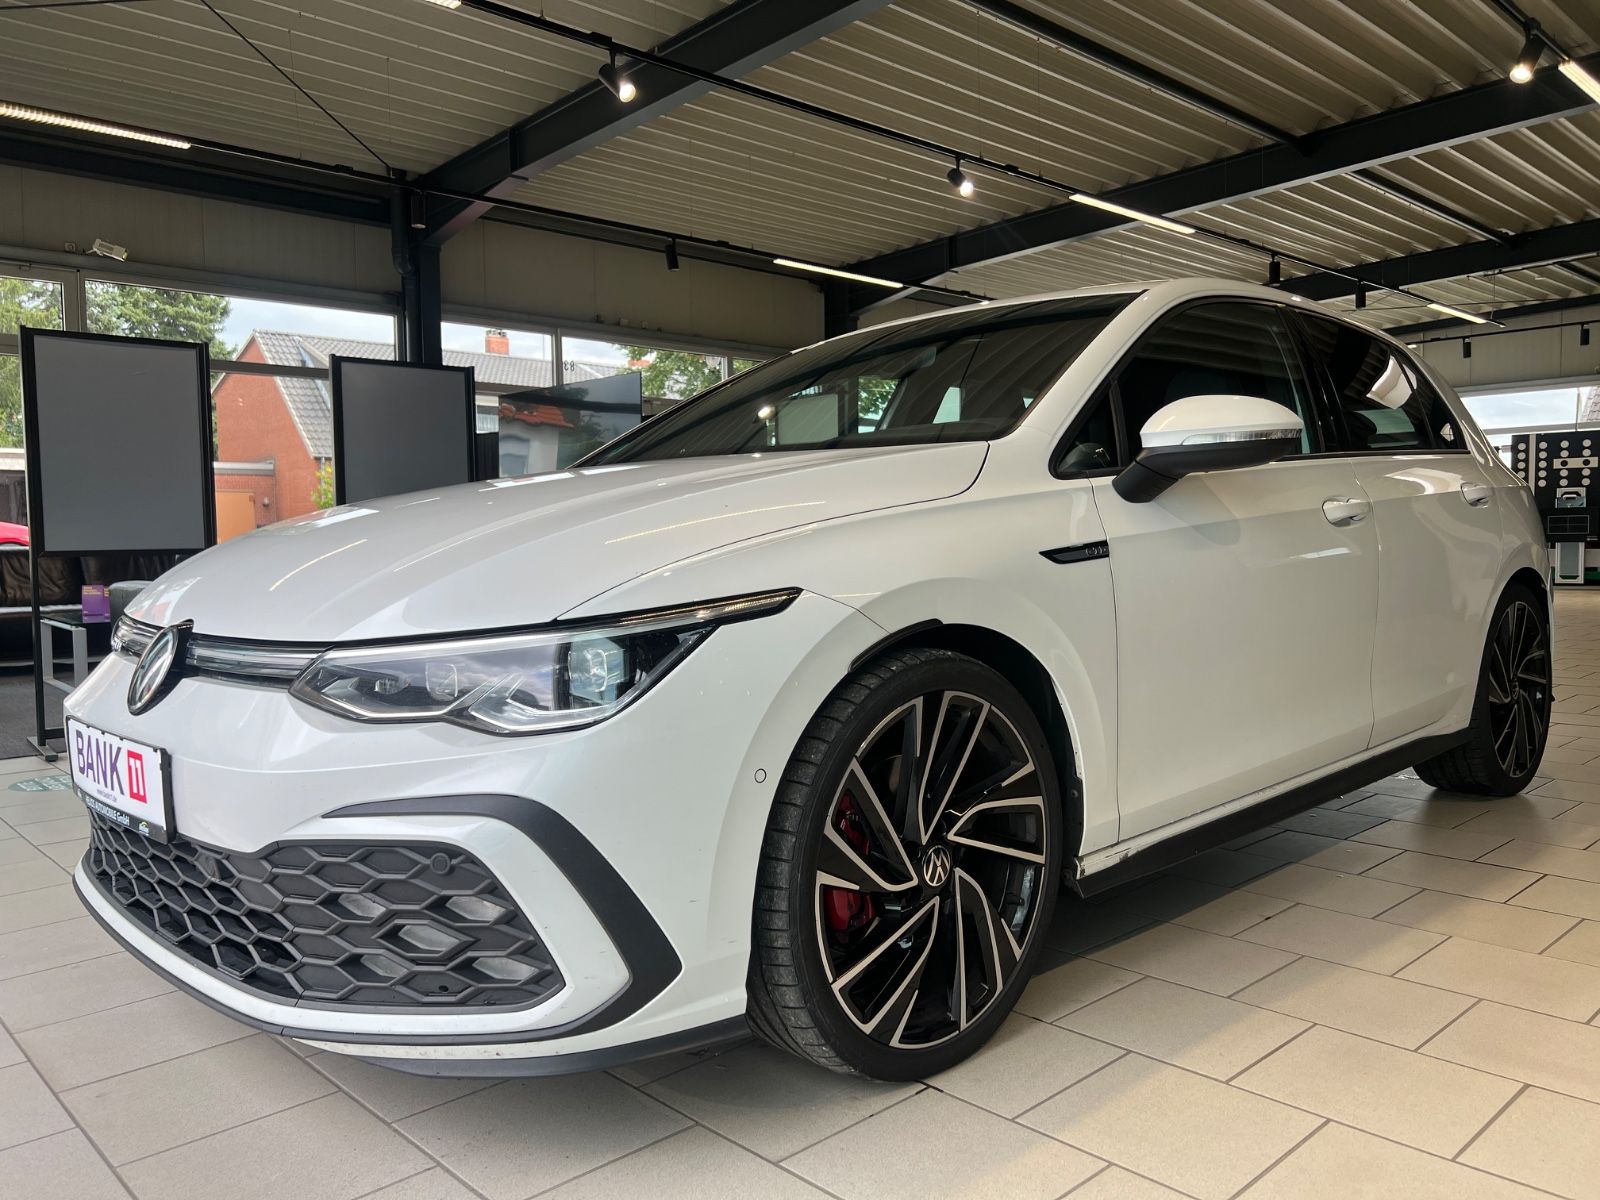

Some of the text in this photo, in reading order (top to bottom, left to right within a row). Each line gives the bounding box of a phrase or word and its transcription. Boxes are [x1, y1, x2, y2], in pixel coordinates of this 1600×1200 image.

[76, 729, 145, 798] BANK 11
[116, 811, 130, 826] GmbH
